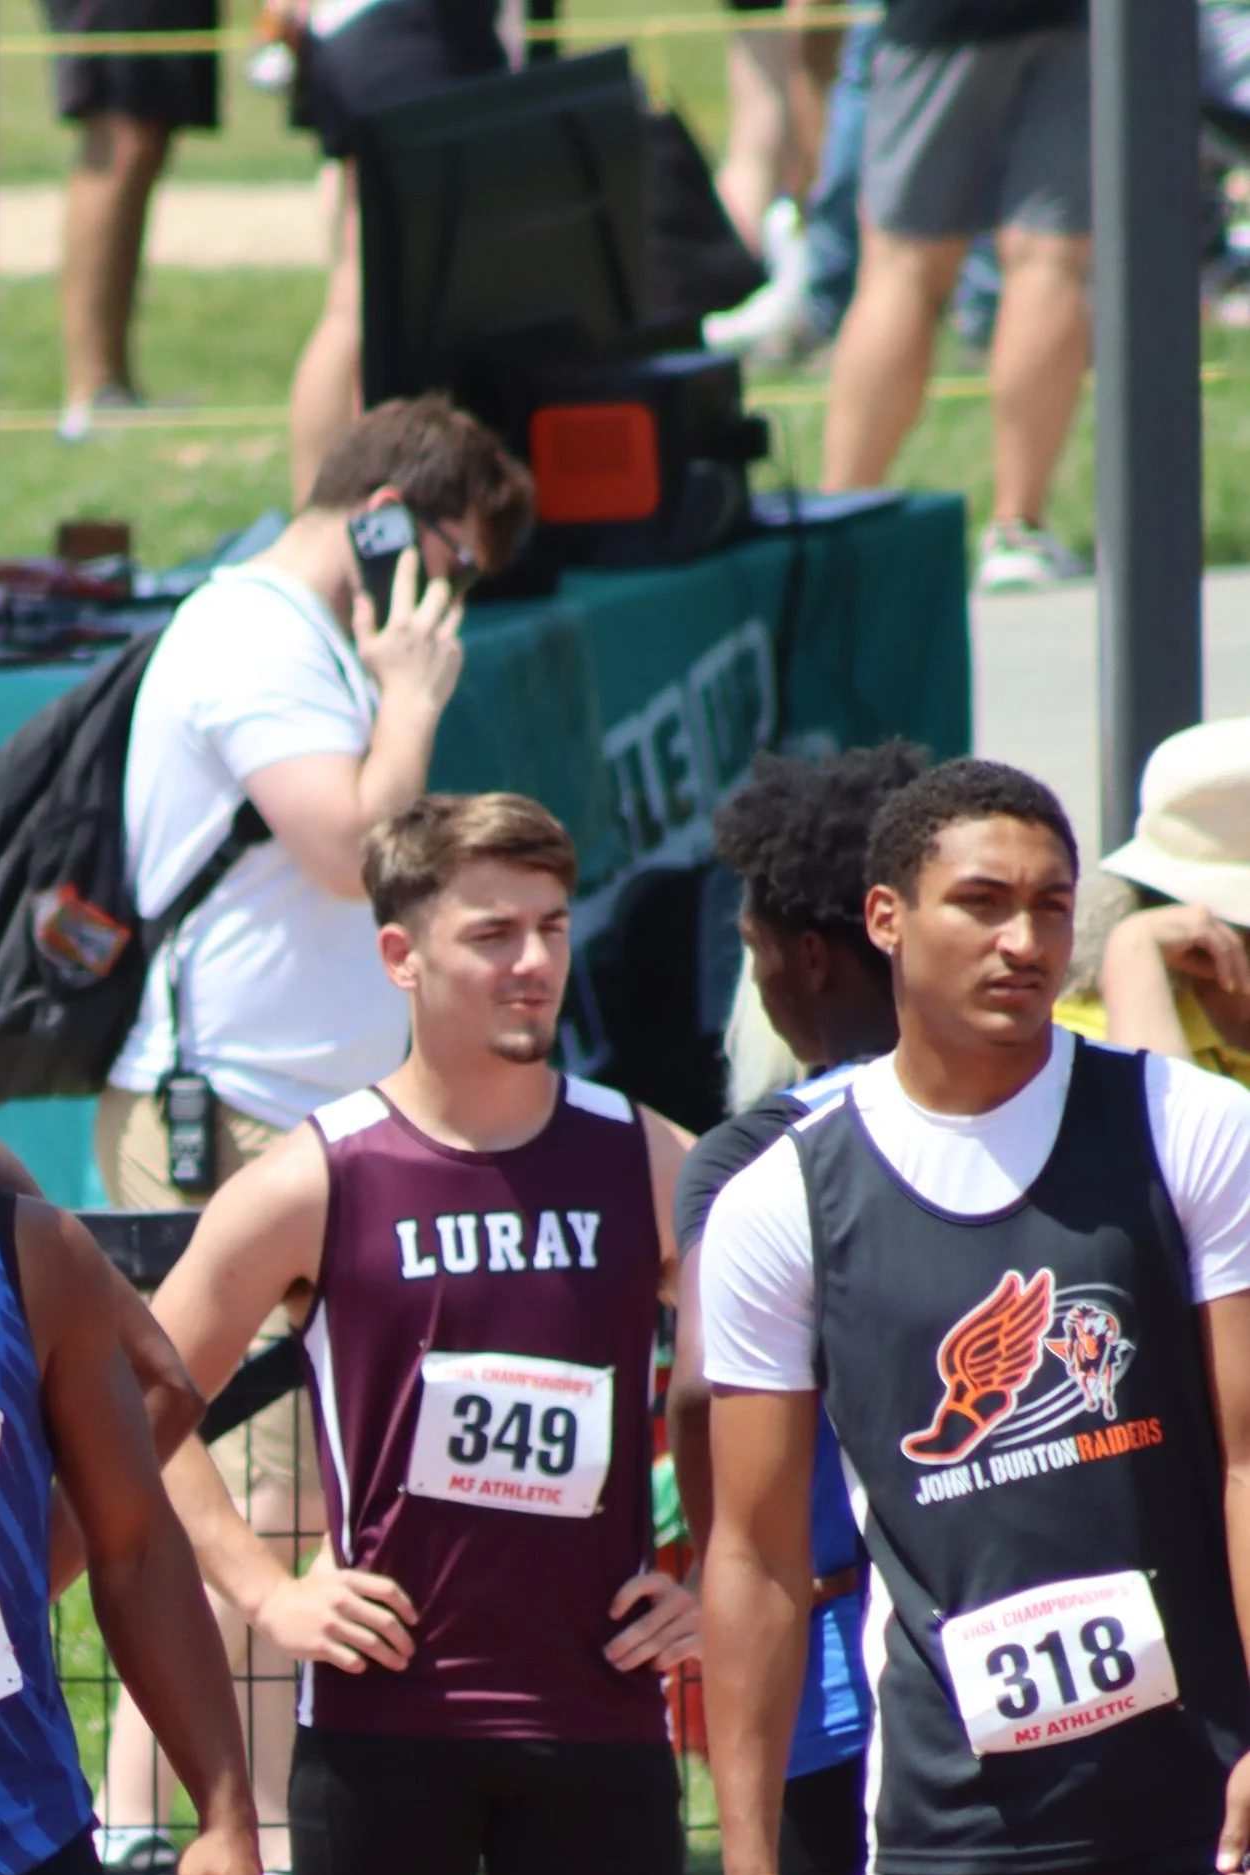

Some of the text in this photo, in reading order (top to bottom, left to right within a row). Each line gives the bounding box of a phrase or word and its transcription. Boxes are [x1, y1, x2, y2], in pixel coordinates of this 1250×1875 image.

[395, 1210, 600, 1279] LURAY
[447, 1394, 577, 1477] 349
[479, 1480, 562, 1504] ATHLETIC
[962, 1585, 1129, 1641] VHSL CHAMPIONSHIPS
[985, 1615, 1136, 1720] 318
[1047, 1695, 1137, 1736] ATHLETIC
